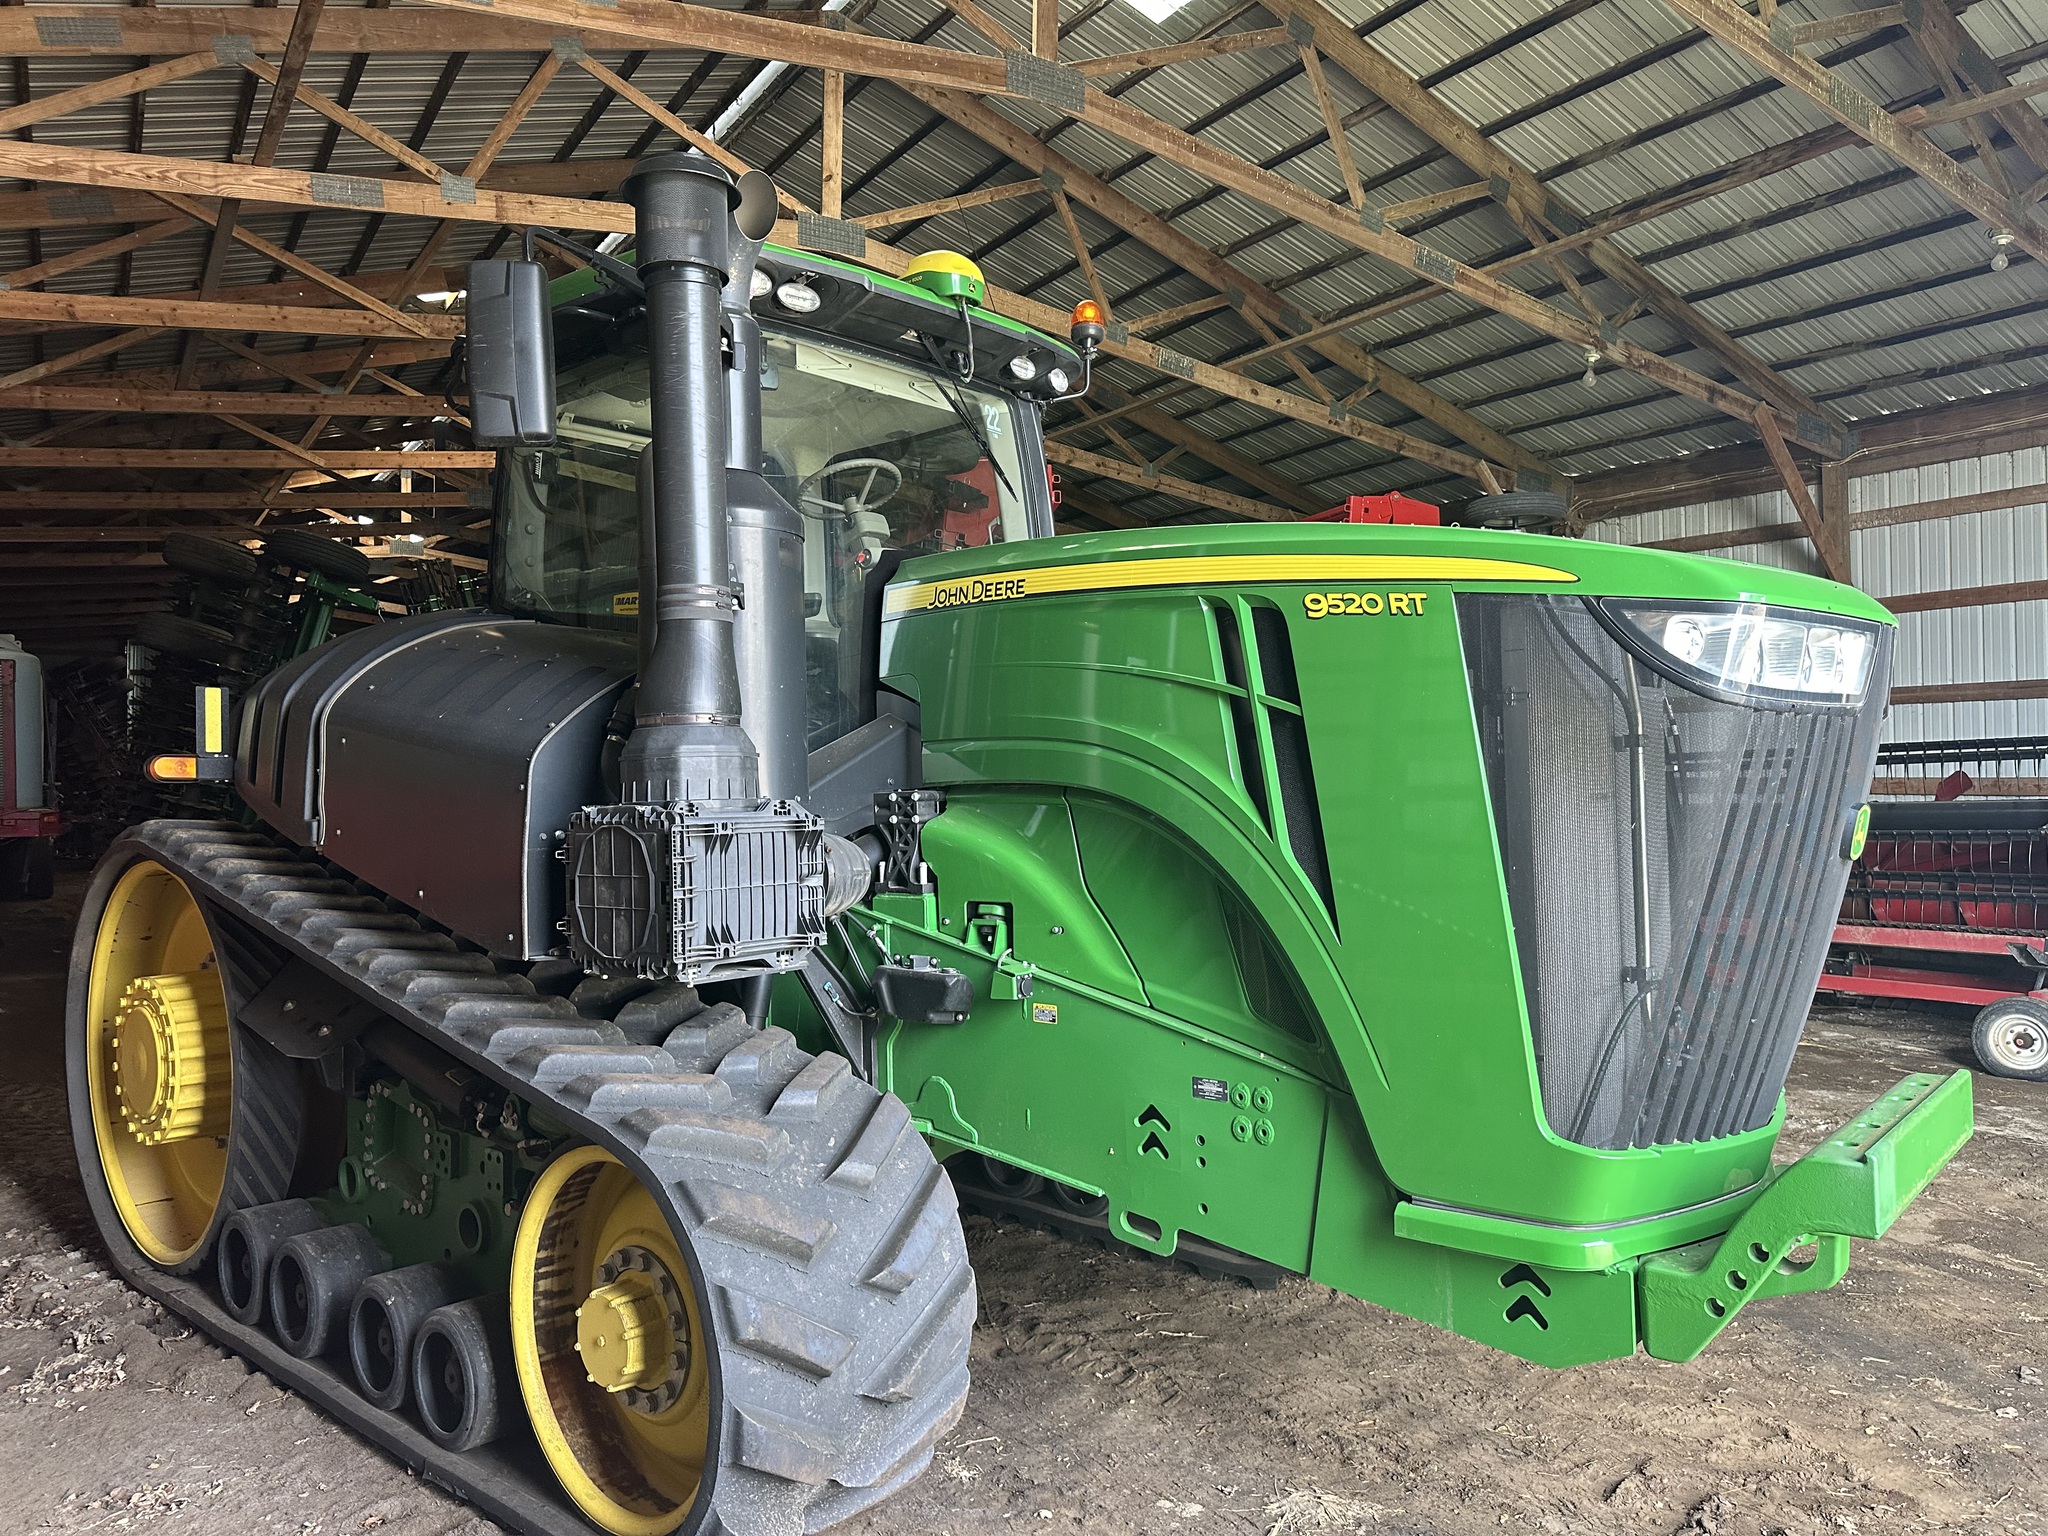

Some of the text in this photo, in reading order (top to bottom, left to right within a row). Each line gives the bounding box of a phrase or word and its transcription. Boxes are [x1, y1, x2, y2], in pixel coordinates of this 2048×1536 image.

[984, 404, 1002, 432] 22
[928, 579, 1026, 607] JOHN DEERE
[1303, 592, 1427, 619] 9520 RT
